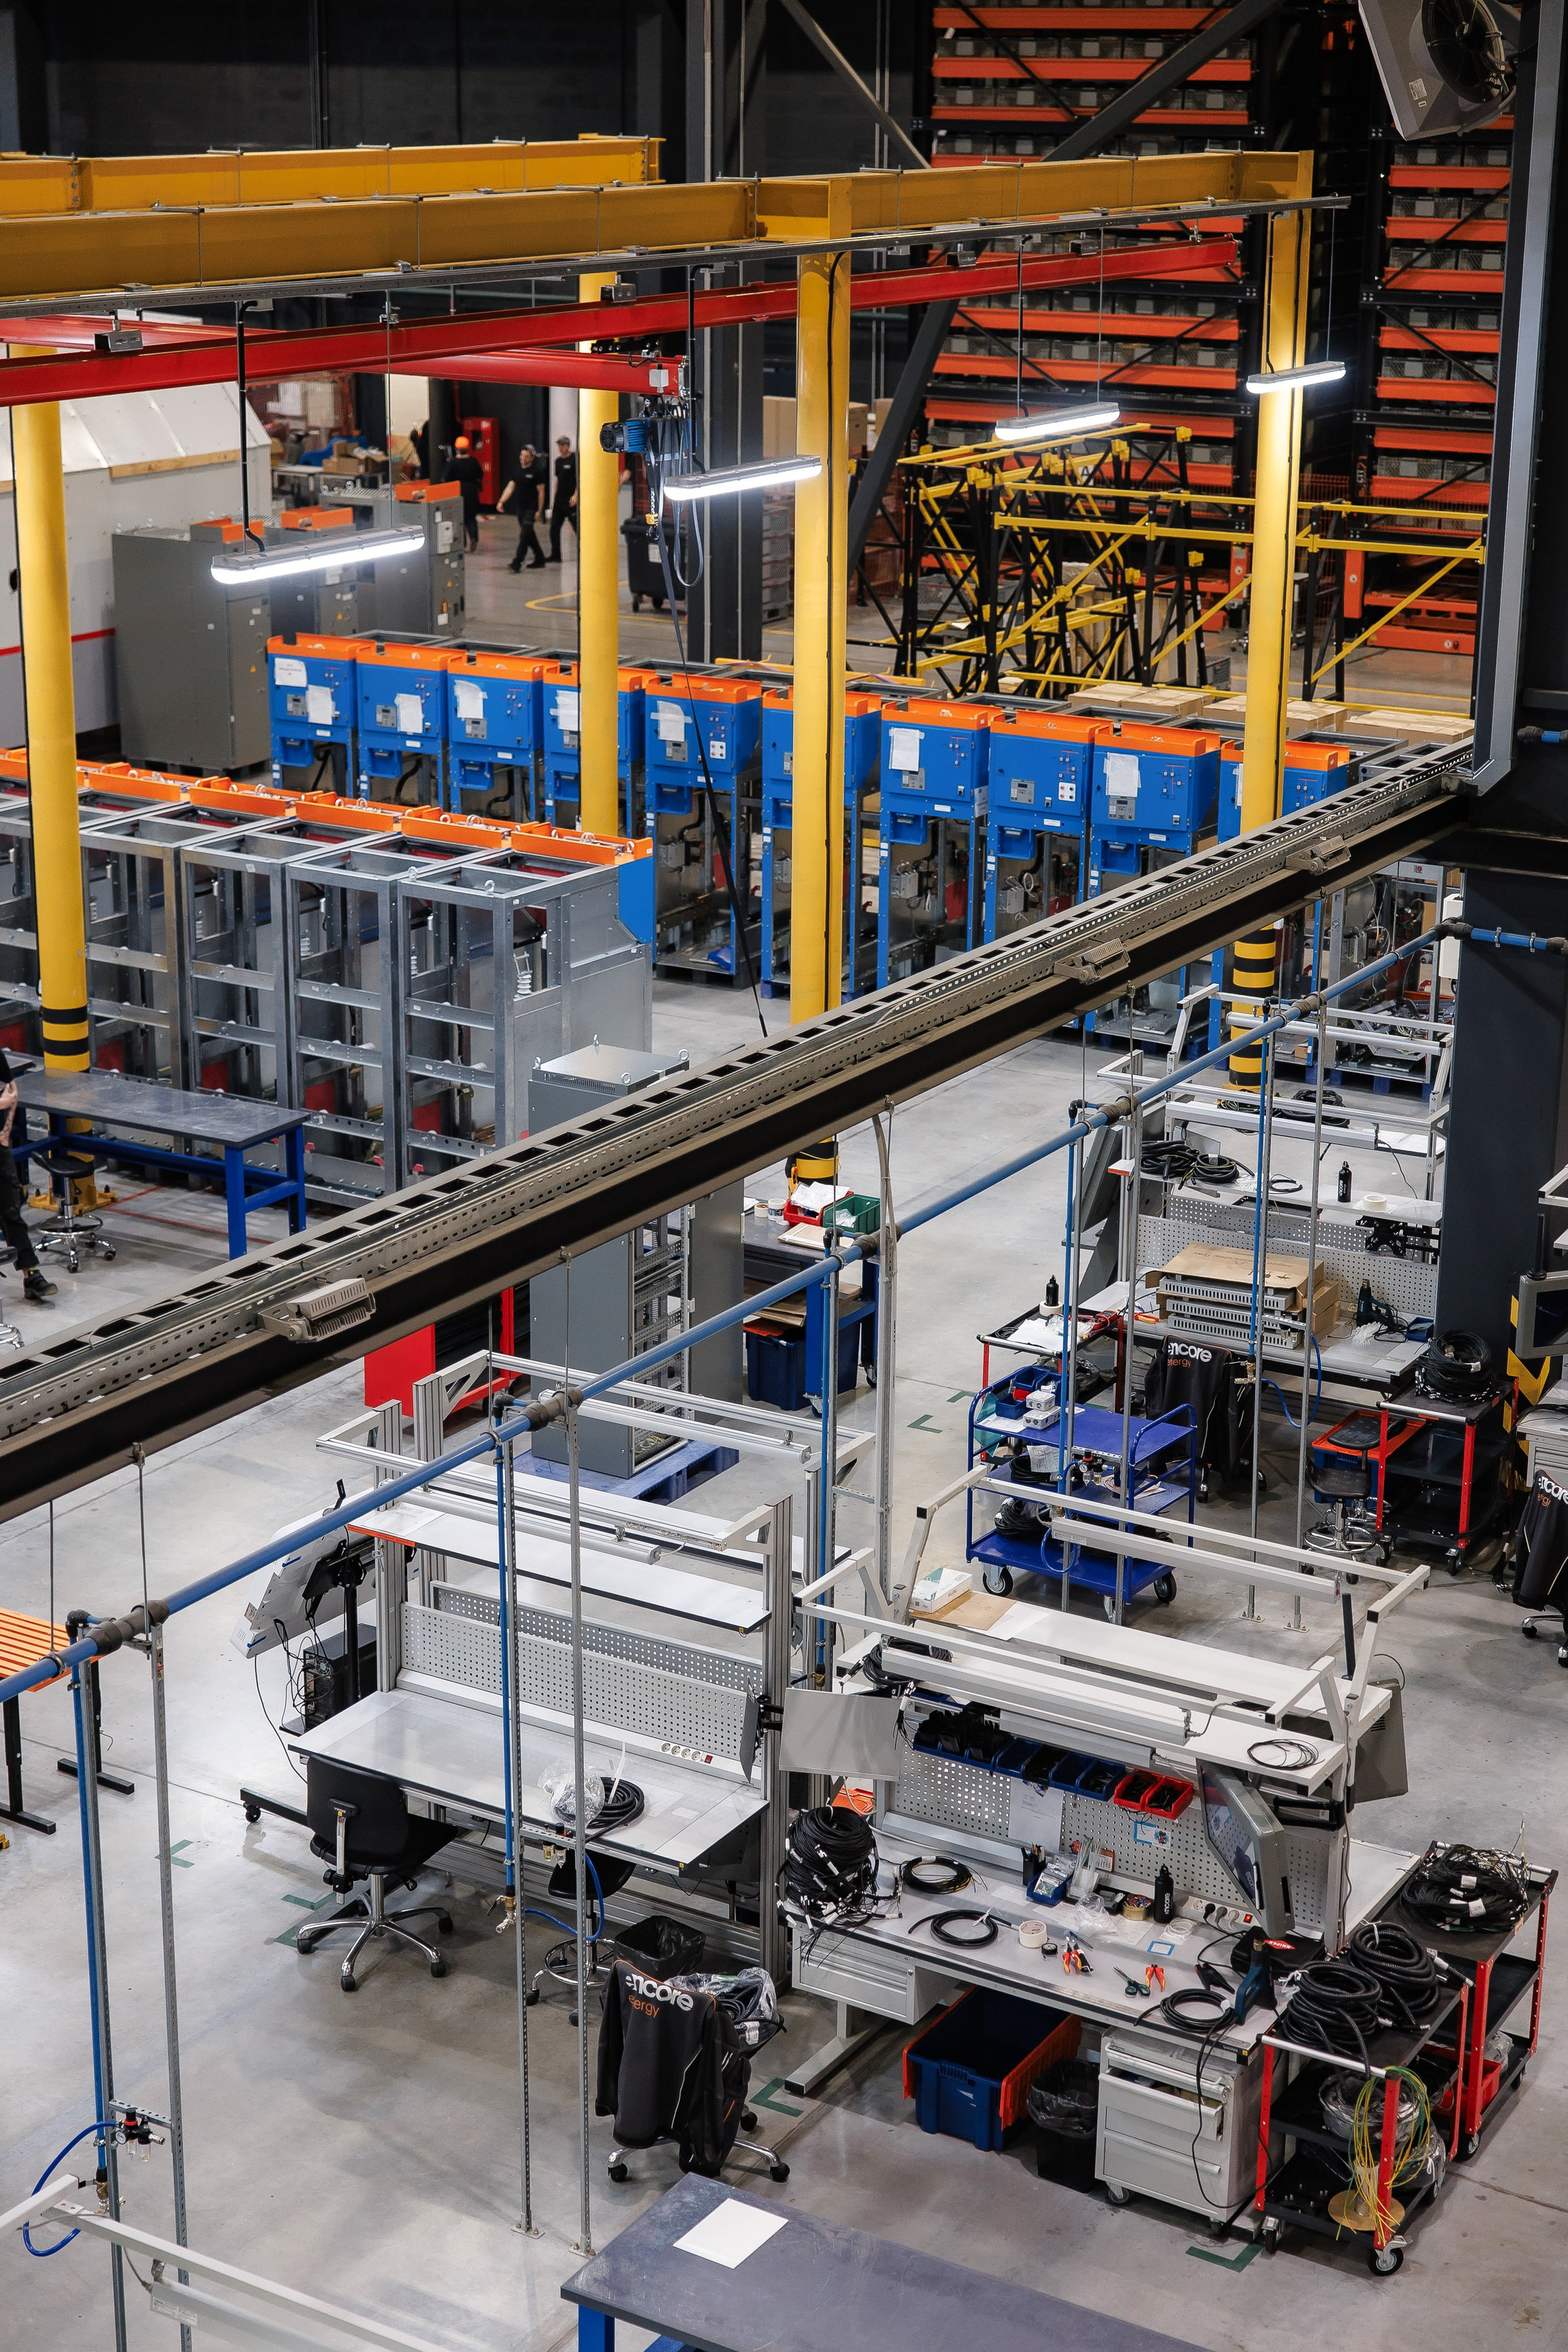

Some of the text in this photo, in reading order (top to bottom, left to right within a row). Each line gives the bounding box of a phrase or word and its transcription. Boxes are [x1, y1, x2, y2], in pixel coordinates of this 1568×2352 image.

[1268, 1940, 1291, 1949] KNIPEX
[625, 1973, 694, 2011] encore
[628, 1994, 660, 2018] eergy
